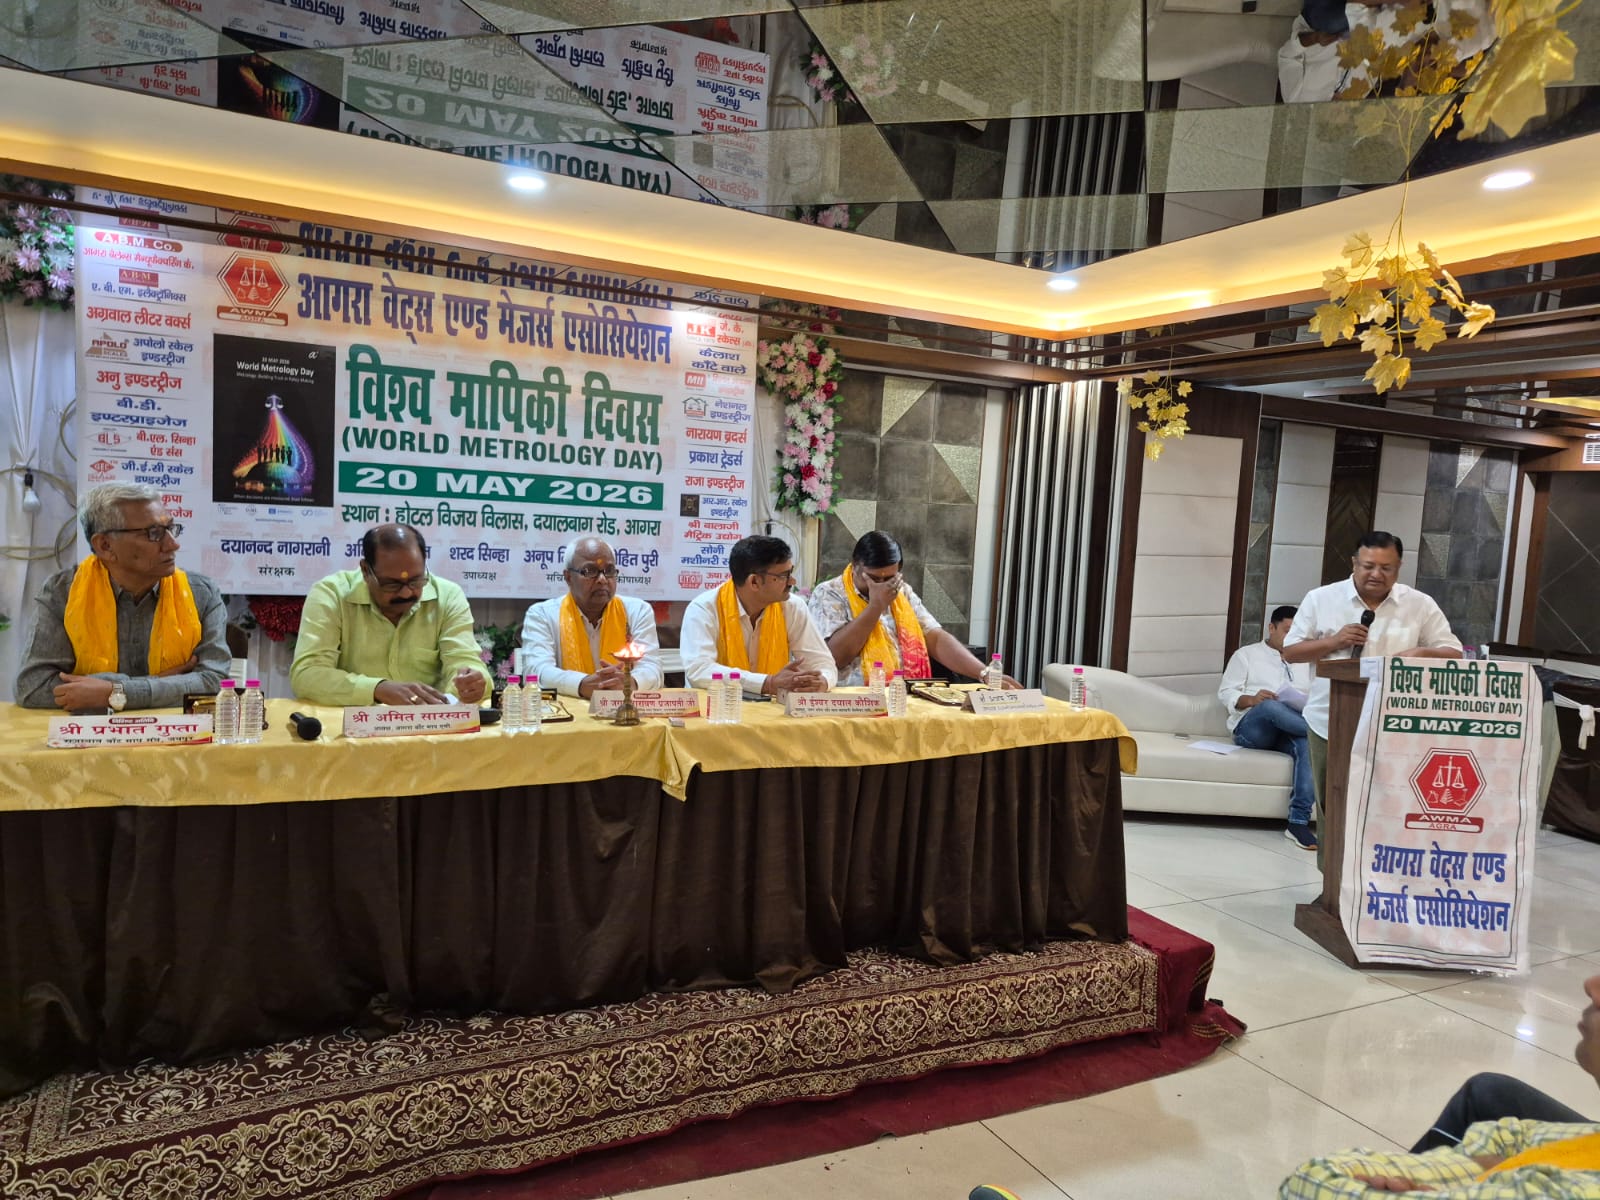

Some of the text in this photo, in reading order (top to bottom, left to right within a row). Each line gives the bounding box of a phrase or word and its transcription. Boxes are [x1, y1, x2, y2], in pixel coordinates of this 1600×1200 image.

[102, 232, 176, 252] A.B.M. Co.
[86, 306, 191, 329] अग्रवाल लीटर वर्क्स
[230, 307, 279, 318] AWMA
[298, 273, 374, 325] आगरा
[381, 271, 436, 344] वेट्स
[442, 294, 490, 340] एण्ड
[497, 289, 555, 349] मेजर्स
[561, 302, 672, 364] एसोसियेशन
[133, 336, 194, 352] अपोलो स्केल
[141, 351, 185, 366] इण्डस्ट्रीज
[699, 347, 740, 361] कैलाश
[236, 361, 260, 371] World
[261, 363, 299, 376] Metrology
[300, 367, 315, 378] Day
[721, 364, 747, 374] वाले
[96, 370, 183, 393] अनु इण्डस्ट्रीज
[345, 344, 663, 445] विश्व मापिकी दिवस
[90, 412, 188, 427] इण्टरप्राइजेज
[171, 432, 196, 446] सिन्हा
[685, 427, 748, 444] नारायण ब्रदर्स
[166, 446, 183, 457] संस
[342, 426, 663, 475] (WORLD METROLOGY DAY)
[689, 449, 743, 469] प्रकाश ट्रेडर्स
[167, 463, 194, 475] स्केल
[356, 467, 653, 505] 20 MAY 2026
[685, 475, 745, 493] राजा इण्डस्ट्रीज
[342, 504, 379, 527] स्थान
[395, 501, 433, 526] होटल
[437, 505, 477, 528] विजय
[481, 504, 528, 532] विलास,
[533, 513, 593, 534] दयालबाग
[596, 512, 620, 535] रोड,
[624, 517, 661, 536] आगरा
[688, 519, 739, 531] श्री बालाजी
[221, 538, 273, 556] दयानन्द
[277, 536, 331, 557] नागरानी
[449, 545, 475, 561] शरद
[478, 543, 509, 562] सिन्हा
[700, 543, 725, 555] सोनी
[523, 549, 554, 568] अनूप
[641, 547, 659, 572] पुरी
[680, 554, 719, 566] मशीनरी
[258, 566, 295, 577] संरक्षक
[462, 569, 497, 581] उपाध्यक्ष
[546, 572, 565, 583] सचि
[1390, 657, 1523, 699] विश्व मापिकी दिवस
[1386, 697, 1523, 717] (WORLD METROLOGY DAY)
[352, 710, 471, 723] श्री अमित सारस्वत
[59, 723, 199, 737] श्री प्रभात गुप्ता
[1387, 718, 1519, 736] 20 MAY 2026
[1419, 815, 1472, 824] AWMA
[1429, 822, 1457, 830] AGRA
[1371, 841, 1507, 887] आगरा वेट्स एण्ड
[1367, 882, 1510, 932] मेजर्स एसोसियेशन
